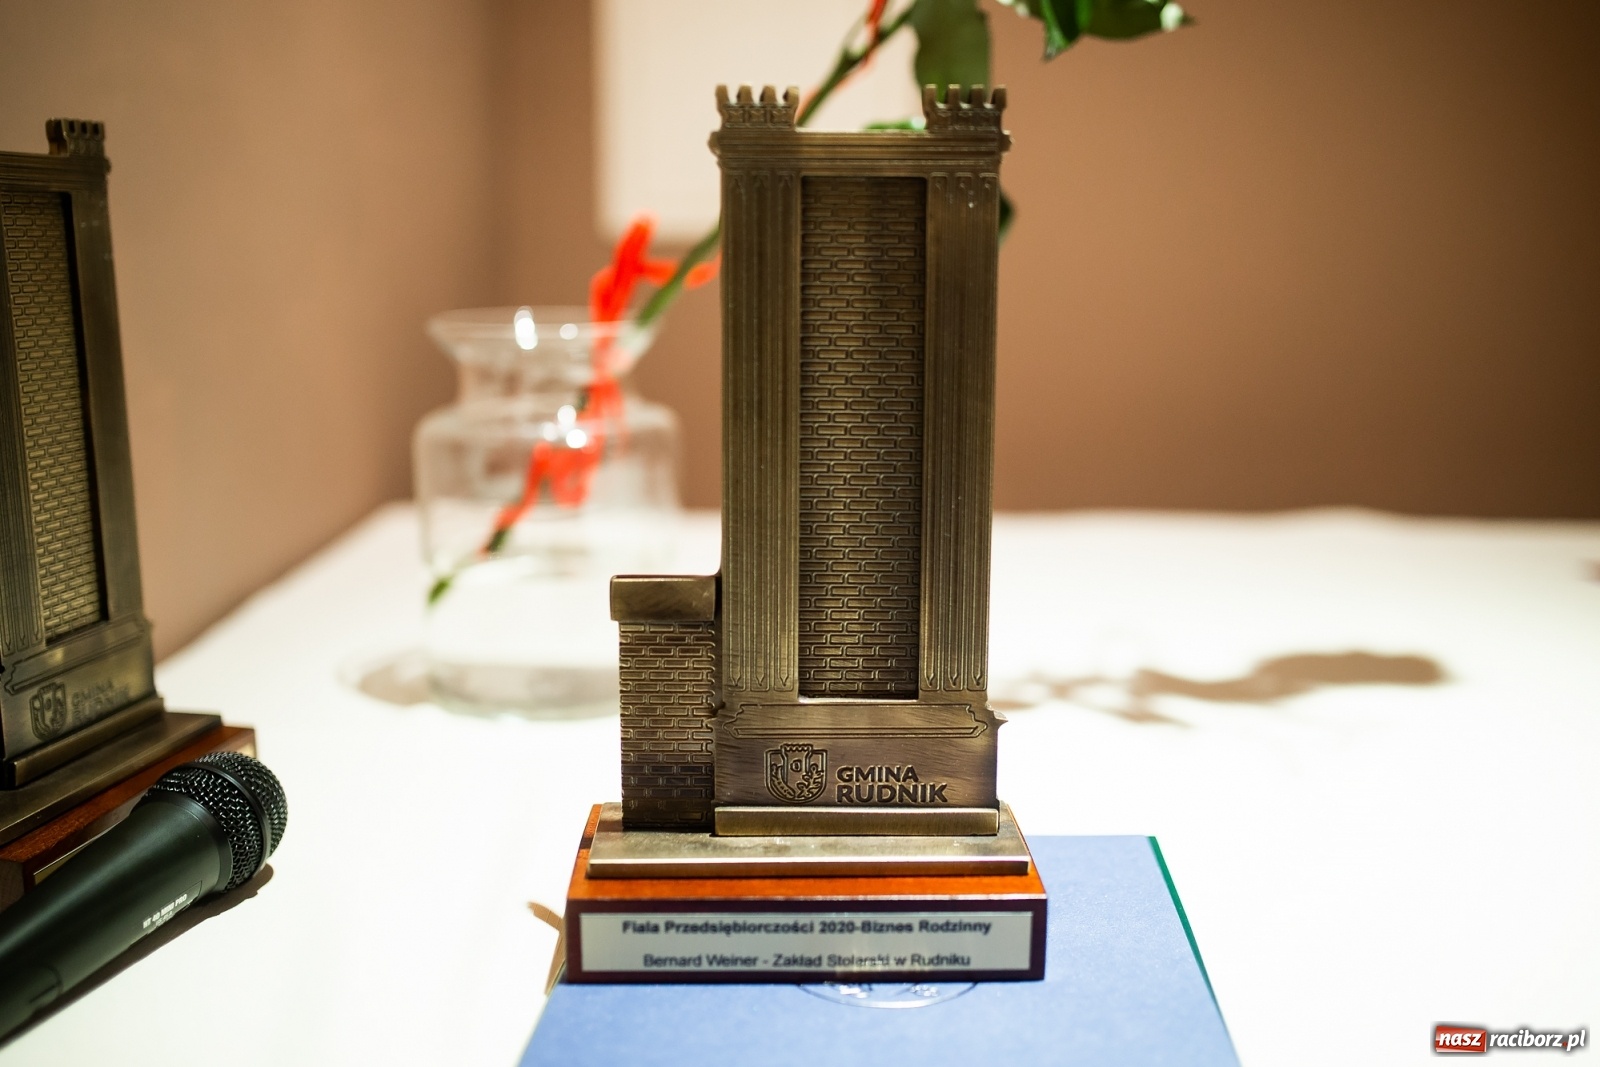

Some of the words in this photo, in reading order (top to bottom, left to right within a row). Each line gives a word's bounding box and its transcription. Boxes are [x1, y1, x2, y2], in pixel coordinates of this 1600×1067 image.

[835, 765, 919, 783] GMINA
[835, 783, 948, 803] RUDNIK
[664, 919, 814, 938] Przedsiębiorczości
[819, 920, 914, 935] 2020-Biznes
[918, 919, 992, 936] Rodzinny
[643, 953, 702, 968] Bernard
[706, 954, 759, 967] Weiner
[772, 953, 822, 967] Zakład
[827, 953, 890, 967] Stolarski
[894, 958, 907, 967] w
[910, 953, 971, 967] Rudniku
